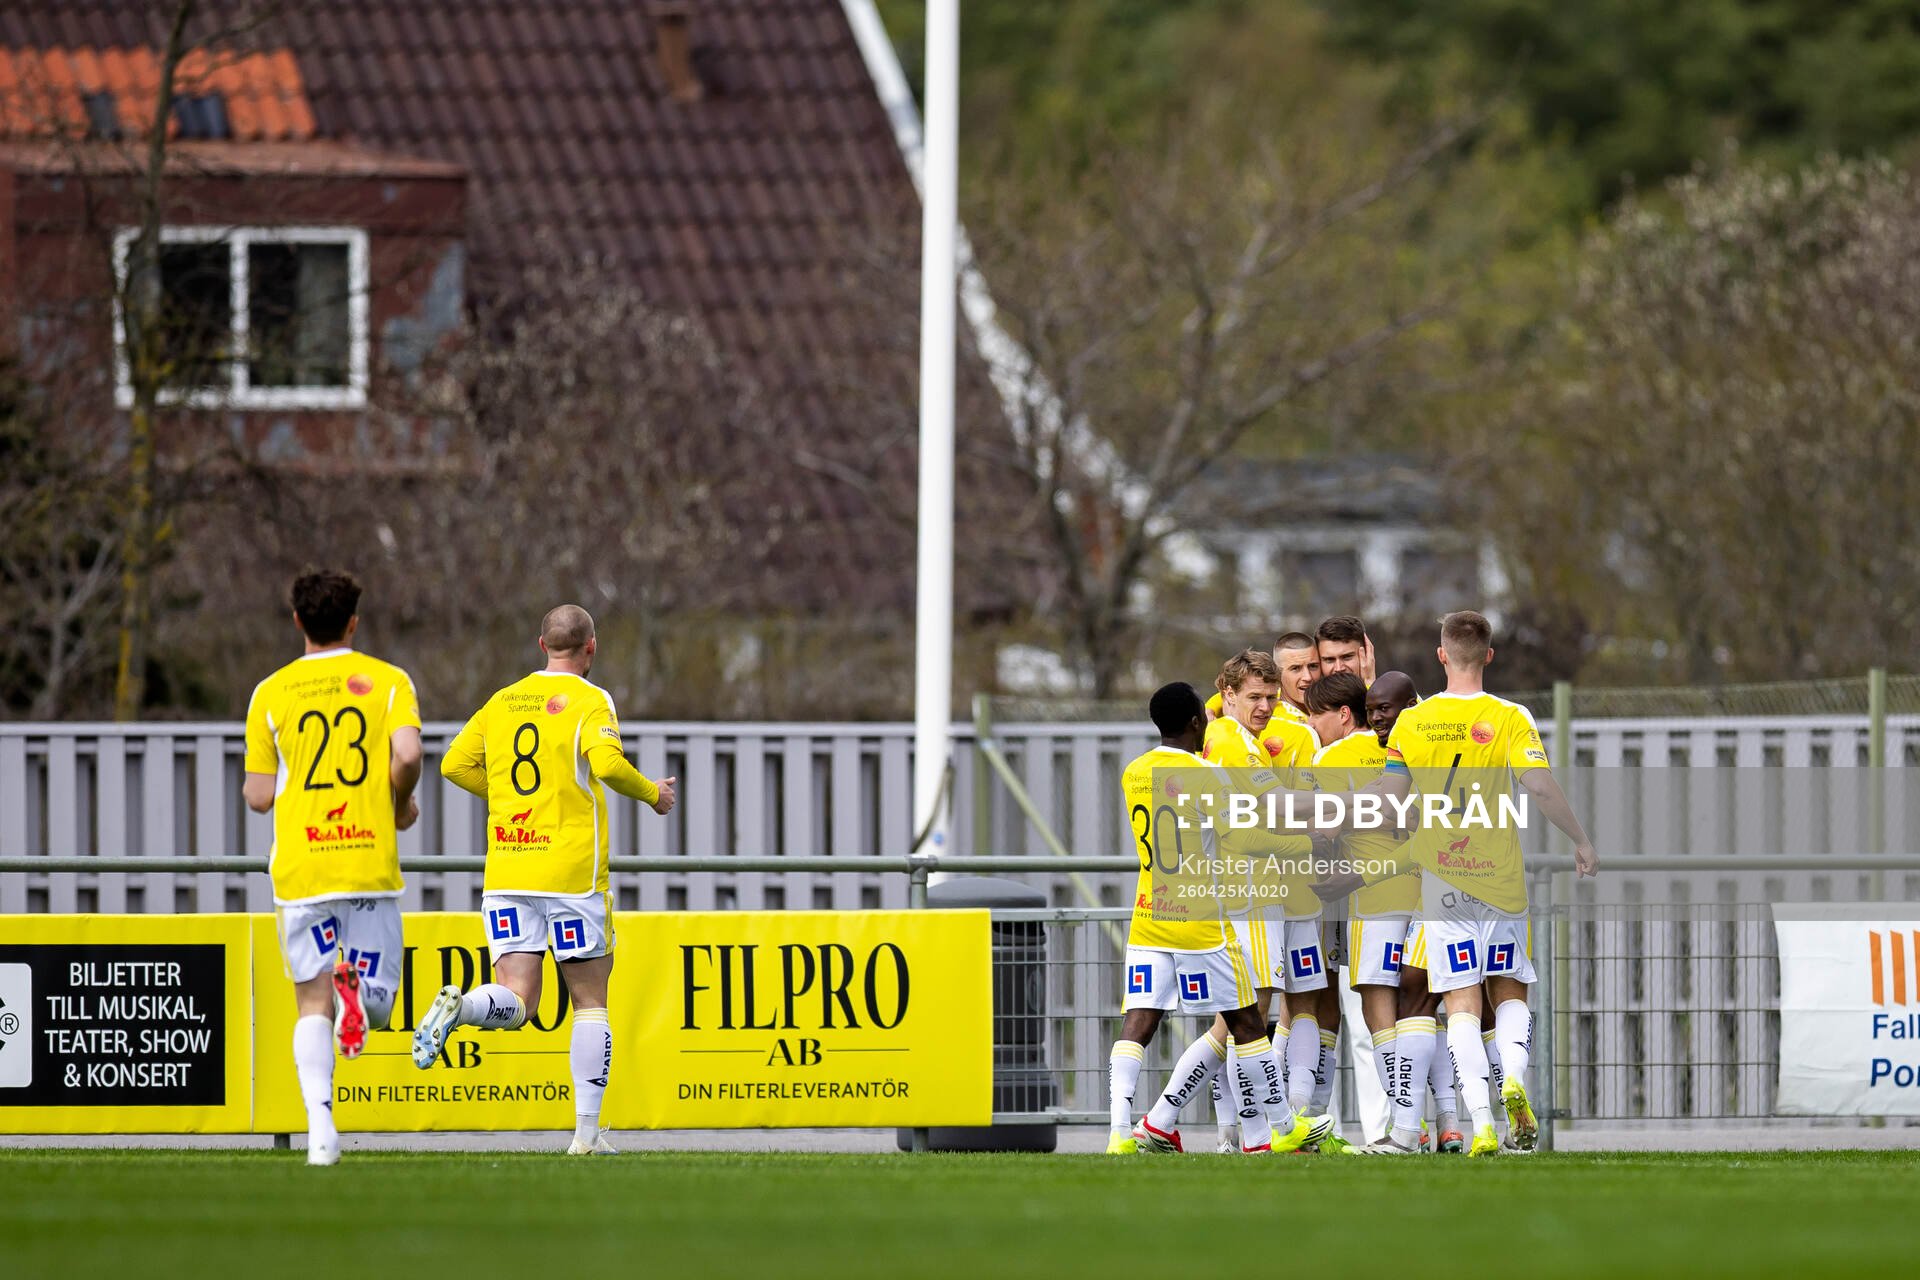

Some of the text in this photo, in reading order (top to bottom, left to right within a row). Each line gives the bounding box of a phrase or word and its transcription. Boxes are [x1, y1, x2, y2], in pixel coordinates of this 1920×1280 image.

[508, 703, 542, 713] Sparbank
[1417, 721, 1467, 732] Falkenbergs
[1426, 731, 1467, 742] Sparbank
[298, 706, 369, 791] 23
[511, 722, 541, 796] 8
[1132, 803, 1183, 875] 30
[69, 962, 182, 987] BILJETTER
[679, 942, 910, 1030] FILPRO
[46, 996, 207, 1024] TILL MUSIKAL,
[44, 1029, 211, 1057] TEATER, SHOW
[602, 1031, 612, 1076] PARDY
[766, 1038, 823, 1067] AB
[64, 1063, 191, 1087] & KONSERT
[678, 1078, 909, 1100] DIN FILTERLEVERANTÖR
[1177, 1060, 1208, 1099] PARDY
[1260, 1059, 1280, 1096] PARDY
[1400, 1056, 1413, 1097] PARDY
[338, 1081, 570, 1102] DIN FILTERLEVERANTÖR
